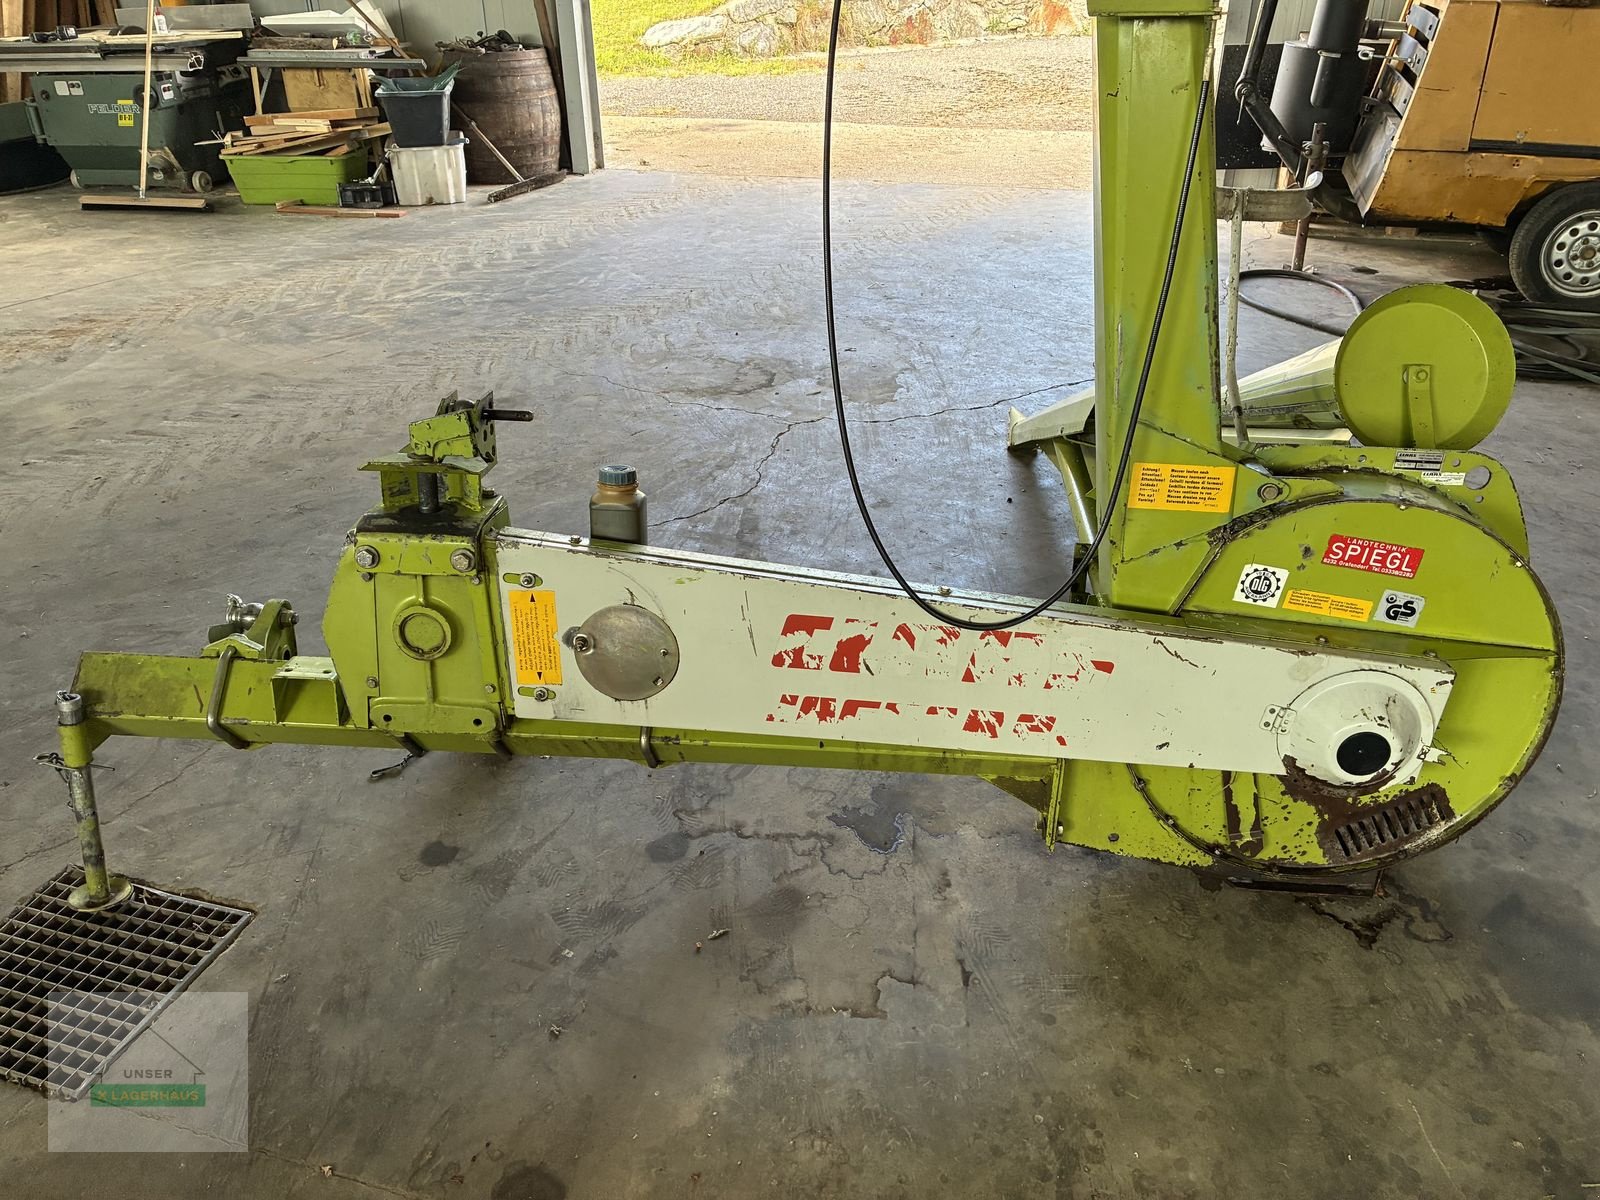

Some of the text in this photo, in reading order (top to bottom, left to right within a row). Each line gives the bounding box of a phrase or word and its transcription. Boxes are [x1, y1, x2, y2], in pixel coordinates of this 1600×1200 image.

[88, 103, 140, 114] FELDER
[1347, 538, 1408, 552] LANDTECHNIK
[1329, 542, 1412, 572] SPIEGL
[1338, 560, 1369, 570] Grafendorf
[1386, 600, 1416, 620] GS
